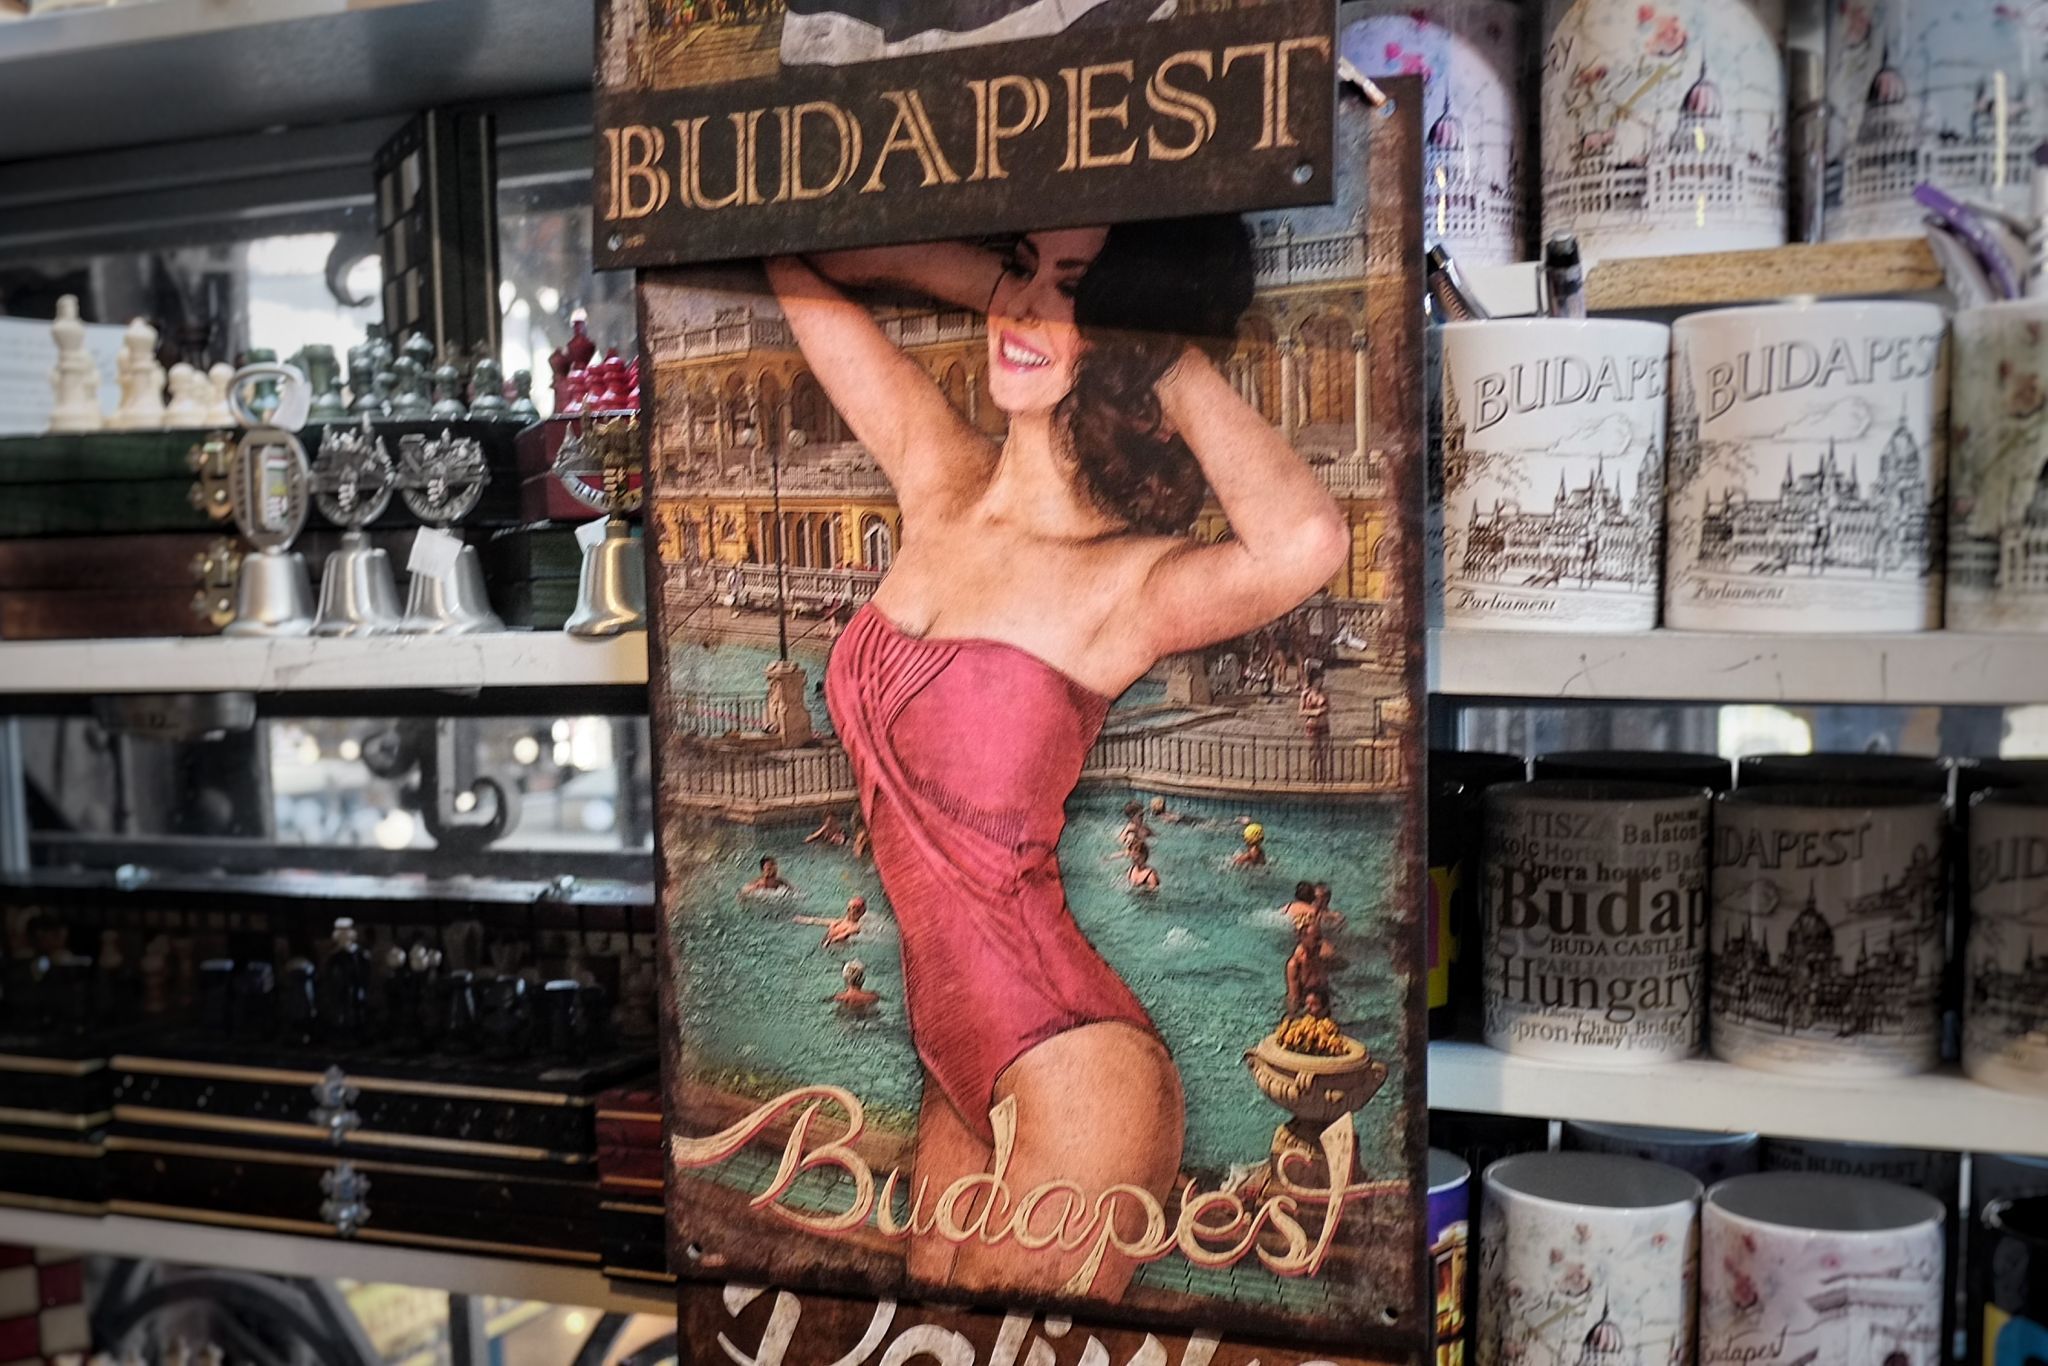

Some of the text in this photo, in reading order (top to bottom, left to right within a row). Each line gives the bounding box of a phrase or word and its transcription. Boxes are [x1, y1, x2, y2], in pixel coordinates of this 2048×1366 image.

[604, 36, 1331, 221] BUDAPEST
[1455, 590, 1556, 611] Parliament
[1692, 578, 1785, 600] Parliament
[1520, 857, 1588, 881] Opera
[1596, 861, 1662, 883] house
[1550, 938, 1608, 957] BUDA
[1614, 936, 1684, 956] CASTLE
[1537, 956, 1667, 977] PARLIAMENT
[1499, 952, 1702, 1024] Hungary
[673, 1085, 1409, 1298] Budapest
